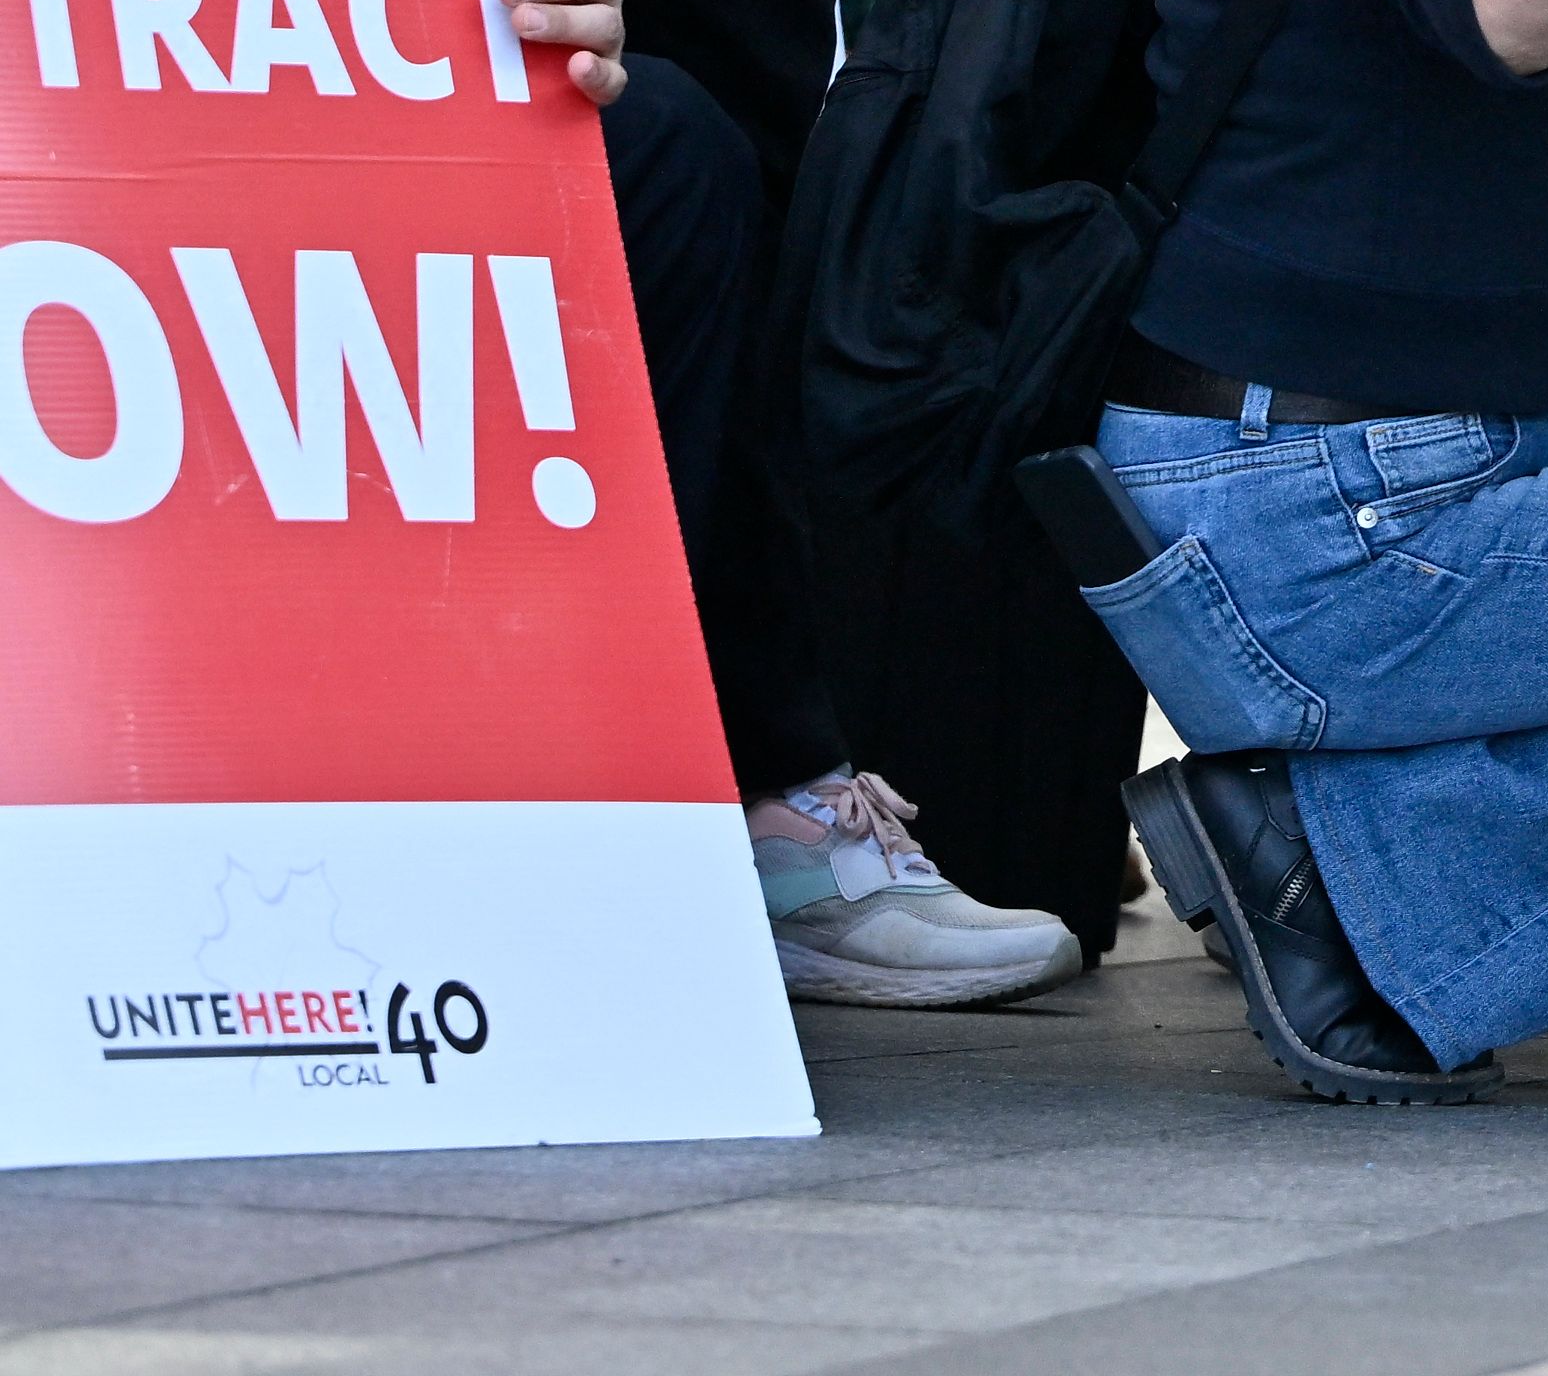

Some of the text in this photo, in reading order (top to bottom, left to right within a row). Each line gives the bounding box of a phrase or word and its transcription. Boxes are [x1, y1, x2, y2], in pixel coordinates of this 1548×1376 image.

[87, 978, 489, 1084] UNITEHERE! 40
[298, 1063, 390, 1087] LOCAL
